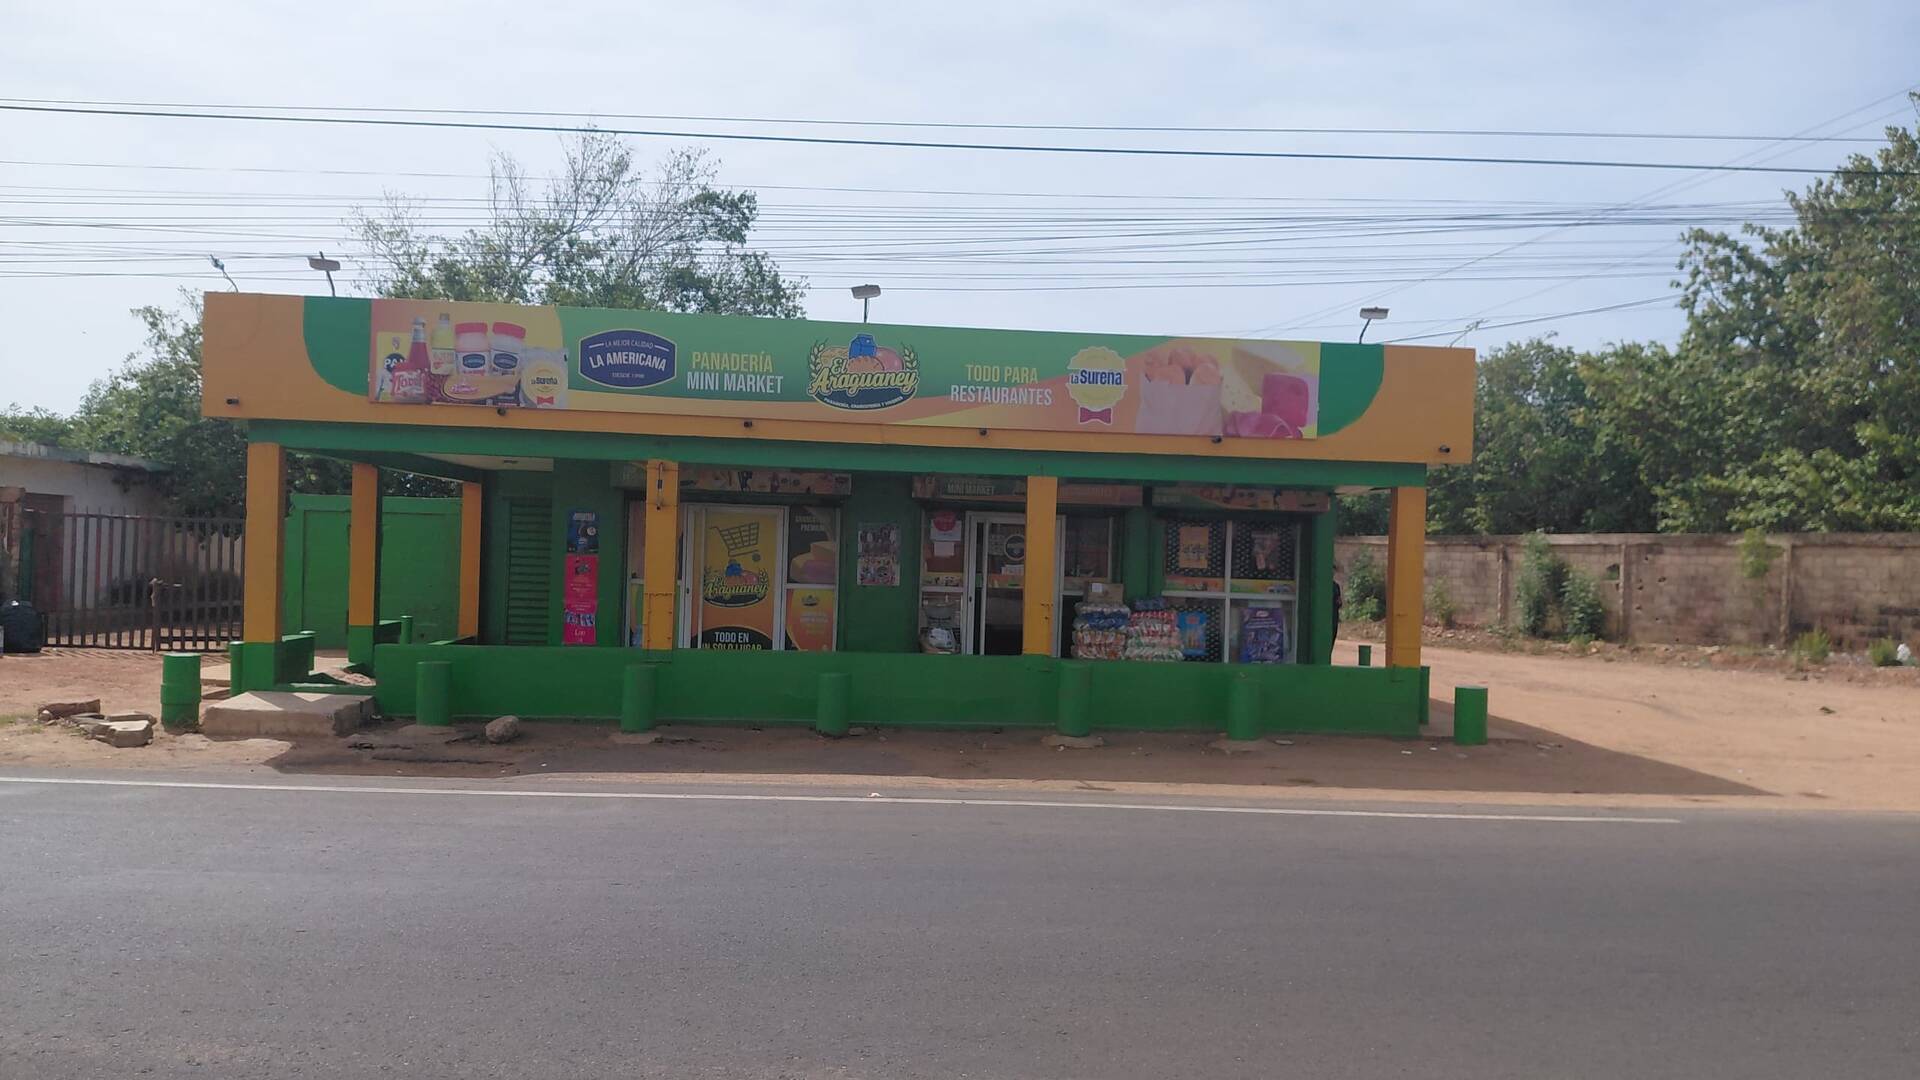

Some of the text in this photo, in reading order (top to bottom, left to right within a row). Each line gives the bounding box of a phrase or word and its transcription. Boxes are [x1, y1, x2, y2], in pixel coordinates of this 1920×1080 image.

[589, 351, 667, 372] LA AMERICANA
[692, 351, 774, 373] PANADERÍA
[831, 357, 848, 374] El
[687, 371, 784, 394] MINI MARKET
[808, 367, 917, 395] Araguaney
[966, 364, 1039, 384] TODO PARA
[950, 385, 1053, 406] RESTAURANTES
[705, 583, 767, 599] Araguaney
[714, 631, 749, 643] TODO EN
